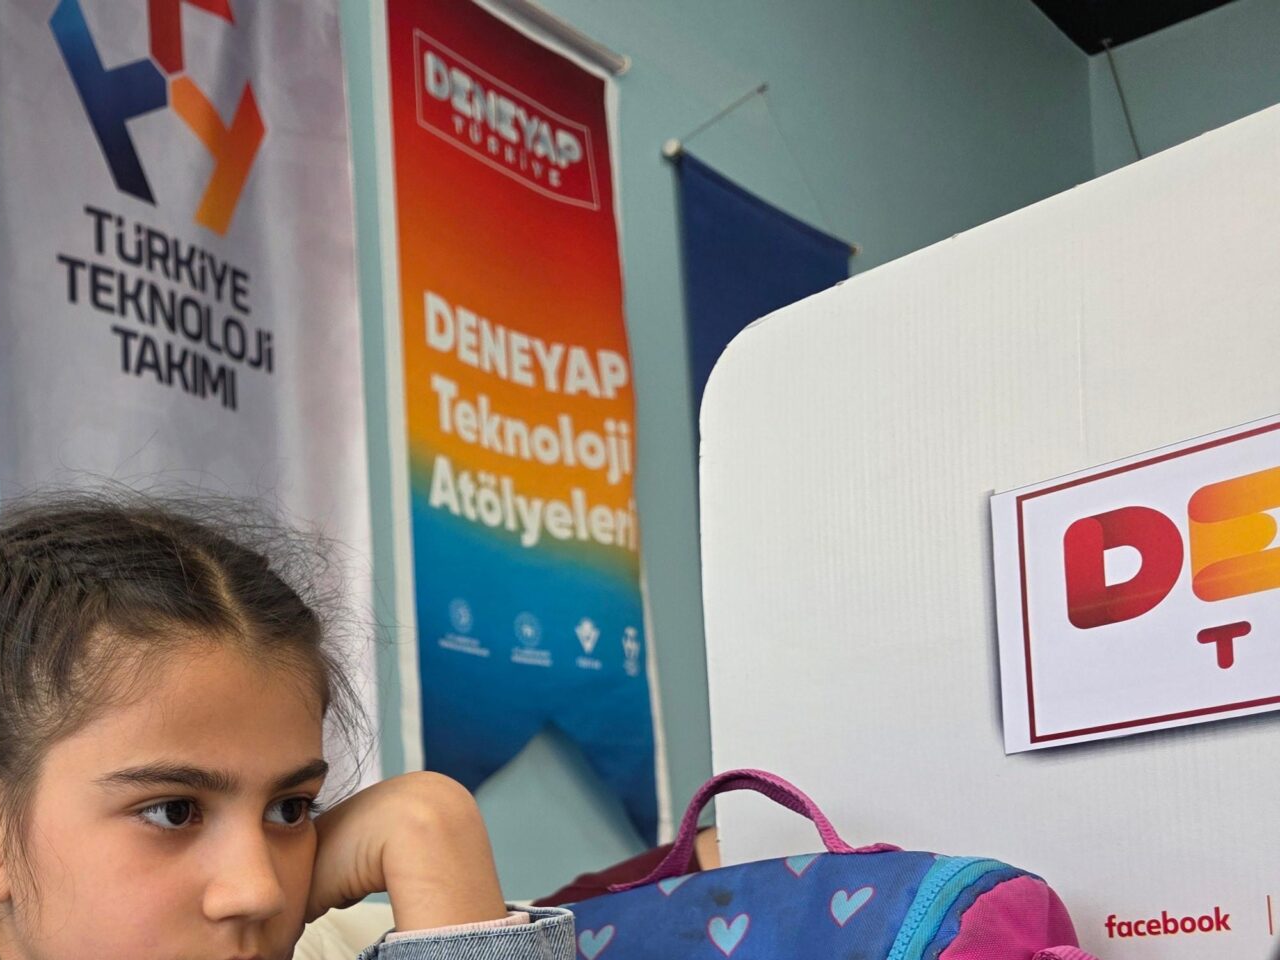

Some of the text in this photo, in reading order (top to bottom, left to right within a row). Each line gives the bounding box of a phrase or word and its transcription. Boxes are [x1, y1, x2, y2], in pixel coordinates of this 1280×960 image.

[424, 50, 583, 168] DENEYAP
[57, 254, 274, 373] TEKNOLOJİ
[84, 204, 252, 314] TÜRKİYE
[111, 325, 238, 412] TAKIMI
[424, 291, 629, 400] DENEYAP
[431, 373, 632, 485] Teknoloji
[1197, 620, 1252, 670] T
[1104, 906, 1232, 939] facebook
